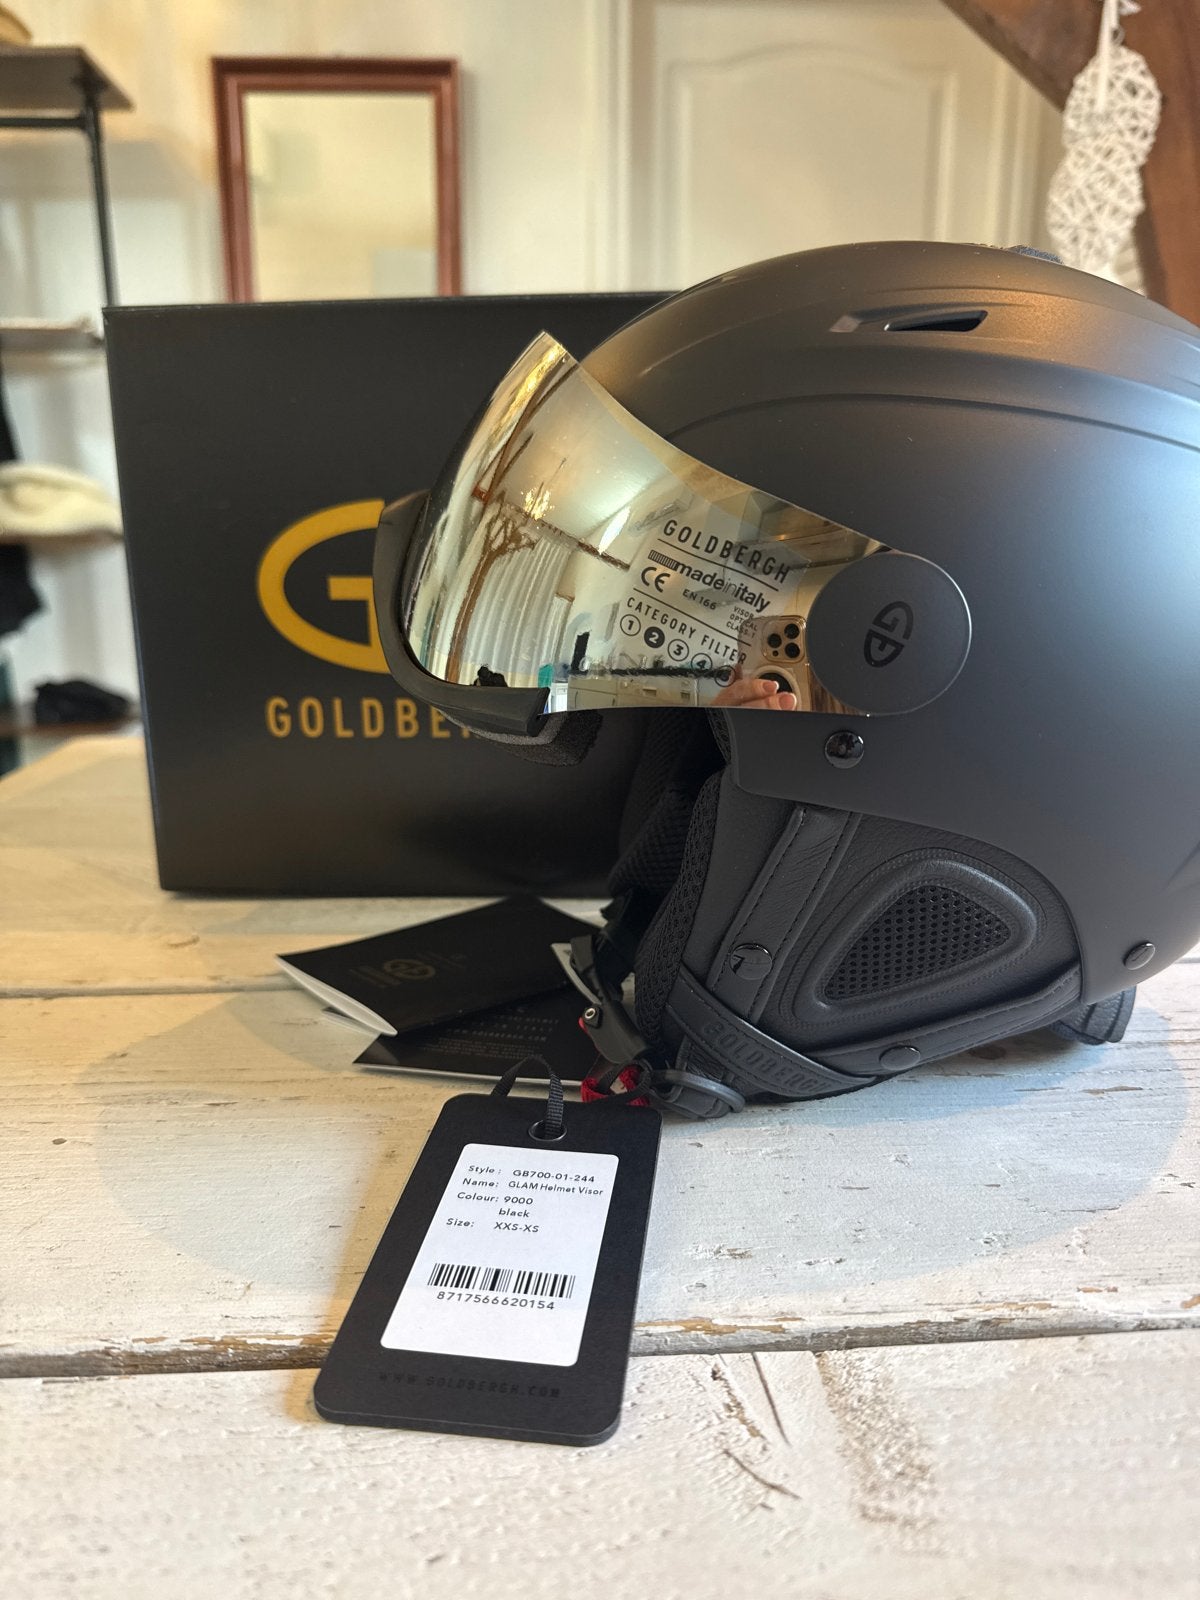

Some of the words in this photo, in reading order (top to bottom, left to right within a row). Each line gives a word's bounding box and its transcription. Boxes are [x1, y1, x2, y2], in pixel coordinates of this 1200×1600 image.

[663, 519, 790, 584] GOLDBERGH
[682, 588, 697, 600] EN
[699, 596, 717, 610] 166
[733, 606, 754, 620] VISOR
[626, 597, 696, 639] CATEGORY
[701, 634, 747, 664] FILTER
[267, 696, 478, 738] GOLDBE
[512, 1169, 595, 1183] GB700-01-244
[462, 1178, 499, 1188] Name:
[508, 1181, 539, 1190] GLAM
[540, 1183, 575, 1194] Helmet
[578, 1186, 604, 1196] Visor
[457, 1192, 499, 1202] Colour:
[504, 1196, 534, 1205] 9000
[498, 1208, 530, 1218] black
[446, 1218, 475, 1228] Size:
[493, 1221, 540, 1233] XXS-XS
[436, 1291, 555, 1310] 8717566620154
